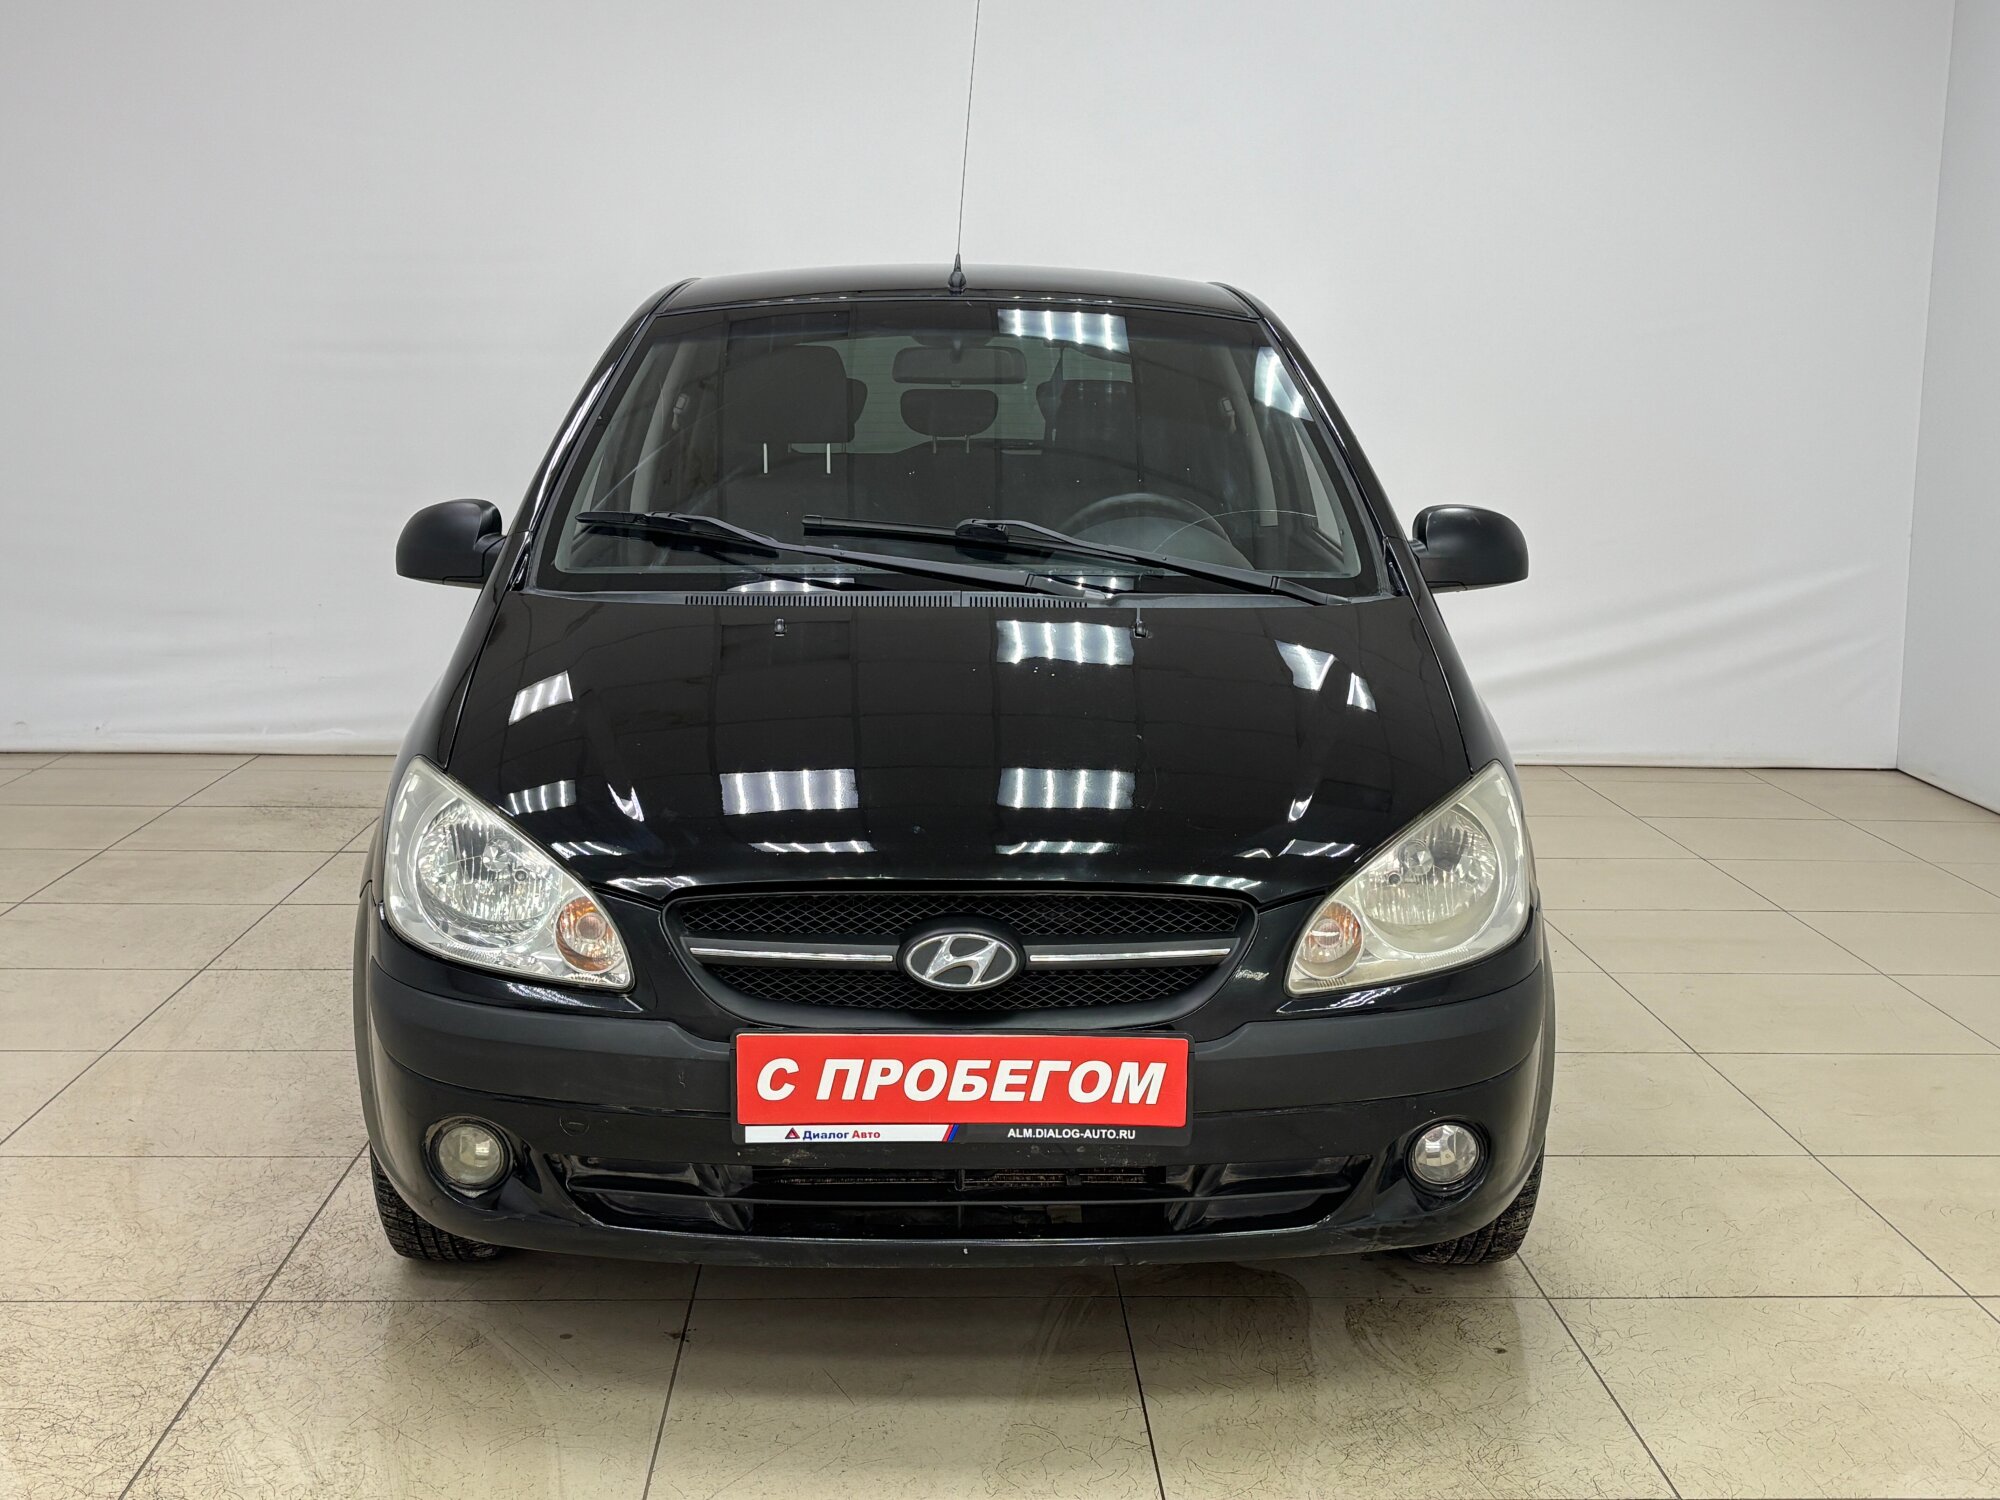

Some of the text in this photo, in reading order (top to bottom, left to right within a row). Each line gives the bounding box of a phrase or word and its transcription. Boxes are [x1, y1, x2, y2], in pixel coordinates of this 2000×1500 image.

[756, 1058, 1167, 1105] С ПРОБЕГОМ
[803, 1130, 881, 1141] Диалог Авто
[1007, 1128, 1136, 1140] ALM.DIALOG-AUTO.RU
